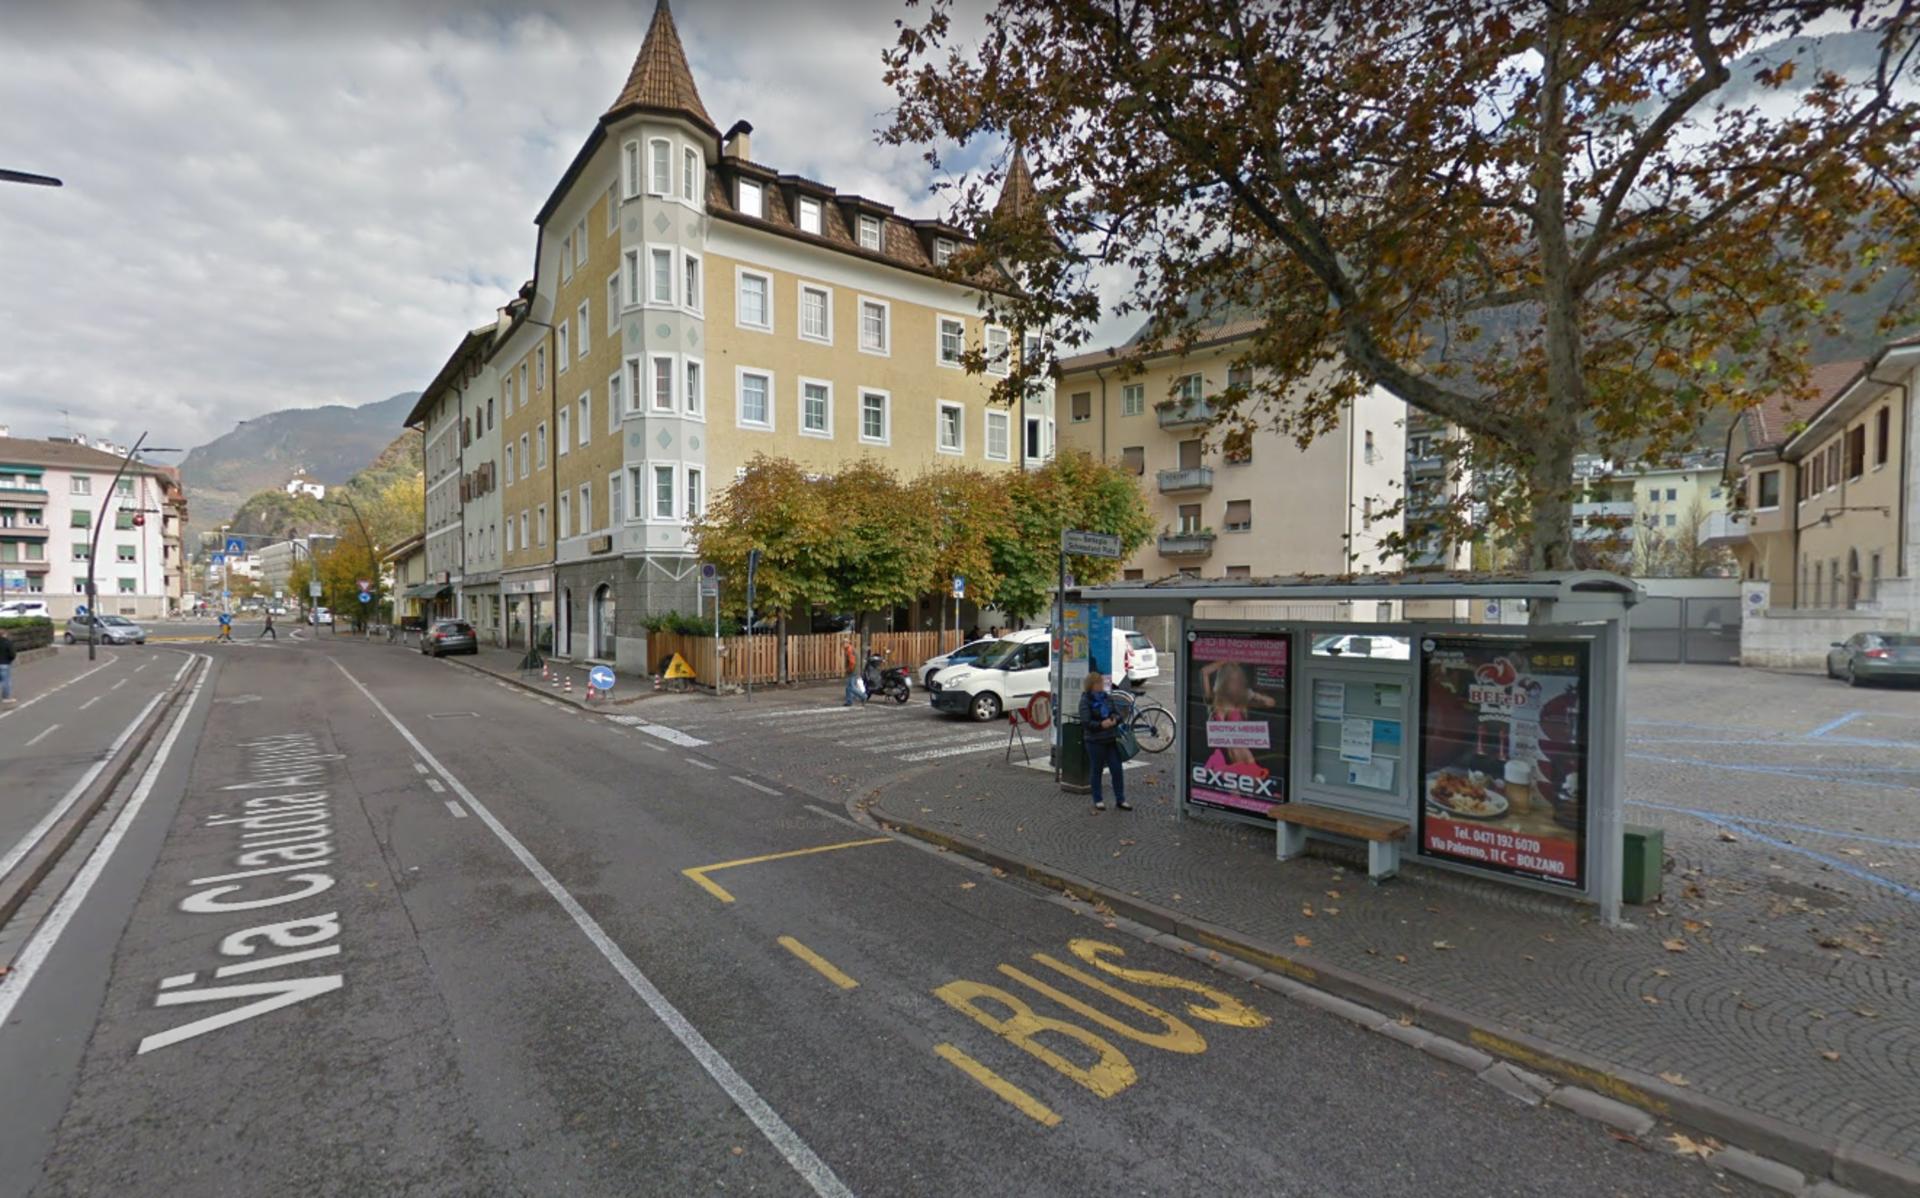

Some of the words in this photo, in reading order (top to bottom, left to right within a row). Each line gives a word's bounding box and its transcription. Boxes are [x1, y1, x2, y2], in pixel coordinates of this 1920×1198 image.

[1192, 766, 1273, 797] exsex
[180, 791, 336, 914] Claudia
[1431, 837, 1445, 849] Via
[1446, 840, 1488, 861] Palermo,
[1500, 850, 1507, 863] C
[1517, 855, 1565, 875] BOLZANO
[1454, 826, 1471, 840] Tel.
[1473, 830, 1495, 844] 0471
[1496, 834, 1513, 848] 192
[1515, 837, 1540, 853] 6070
[137, 911, 344, 1056] Via
[930, 938, 1272, 1099] BUS
